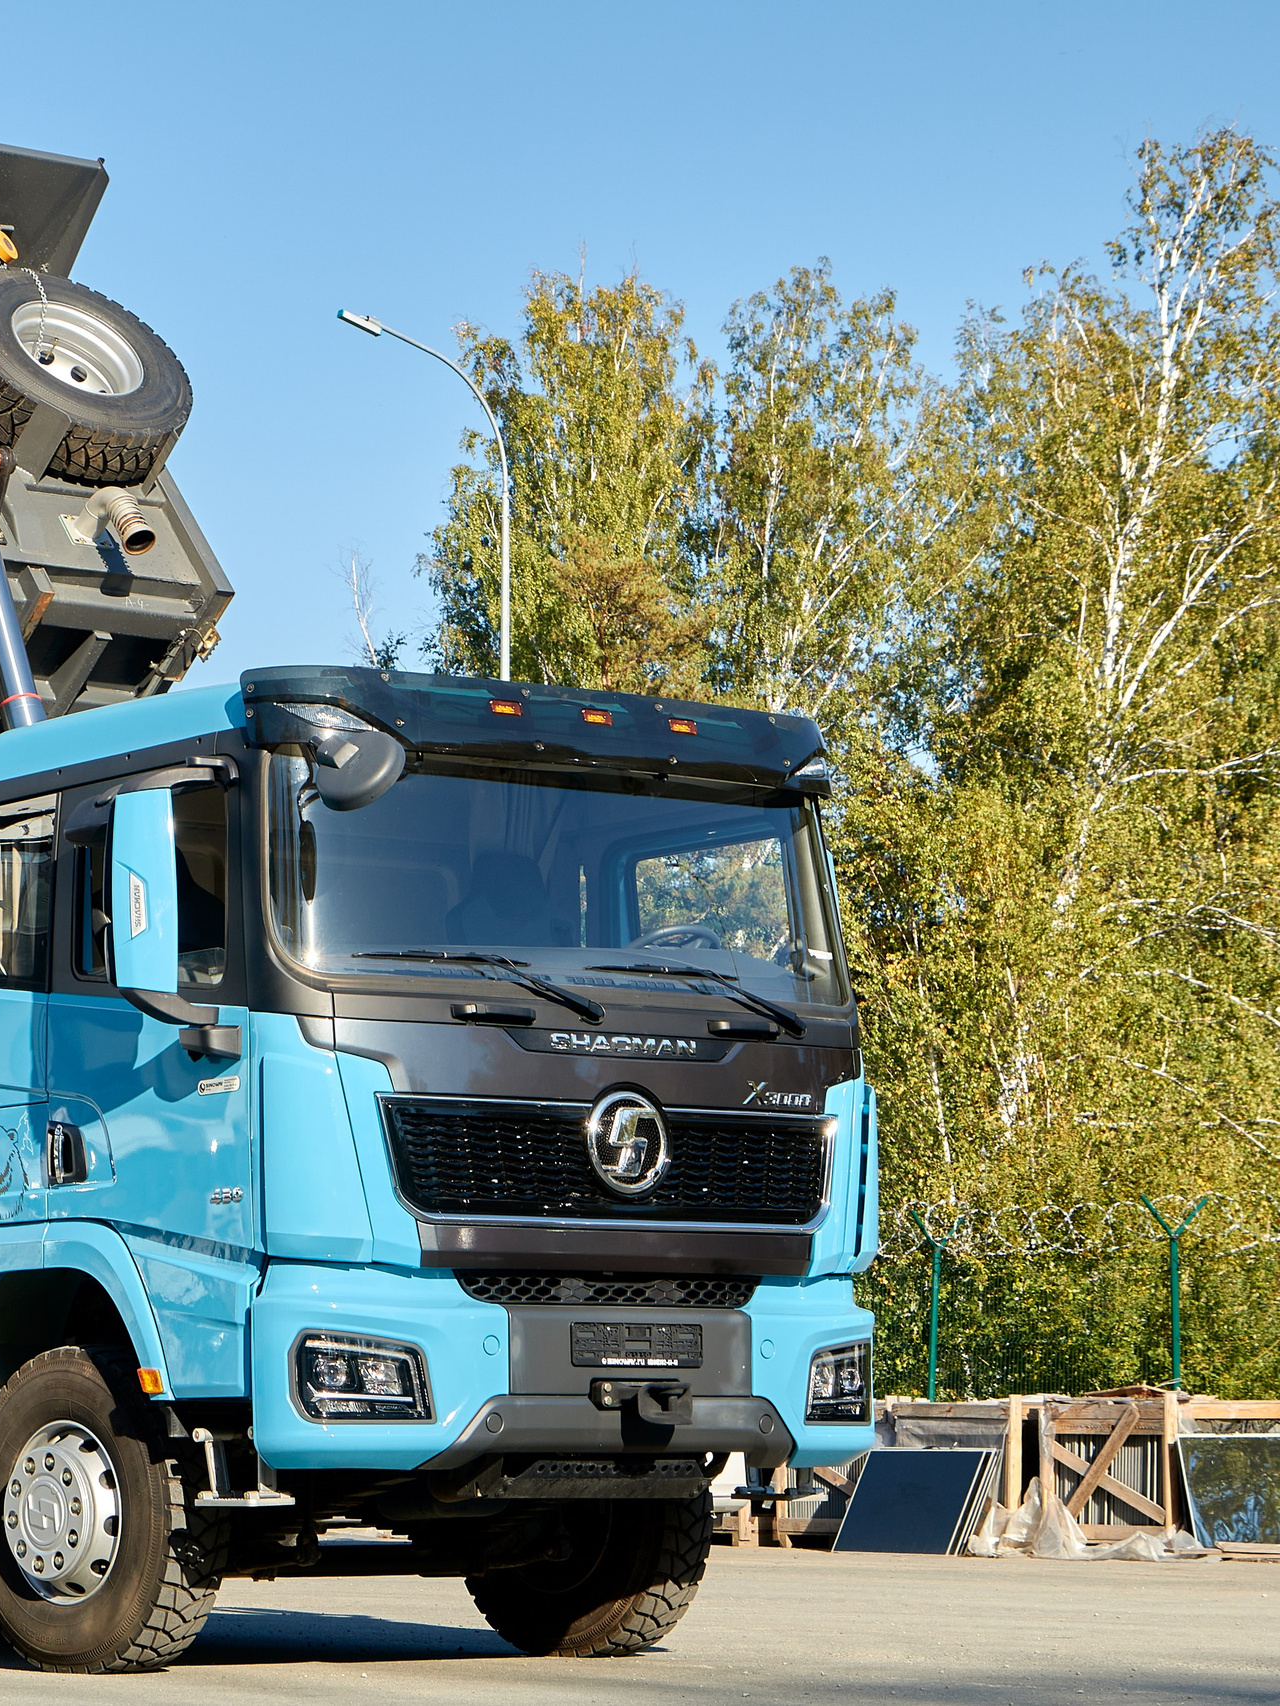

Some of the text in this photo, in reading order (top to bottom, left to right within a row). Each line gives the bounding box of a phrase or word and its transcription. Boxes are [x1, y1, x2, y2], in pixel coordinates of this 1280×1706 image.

[133, 884, 142, 928] SHACMAN
[550, 1032, 697, 1058] SHACMAN
[742, 1080, 812, 1107] X3000
